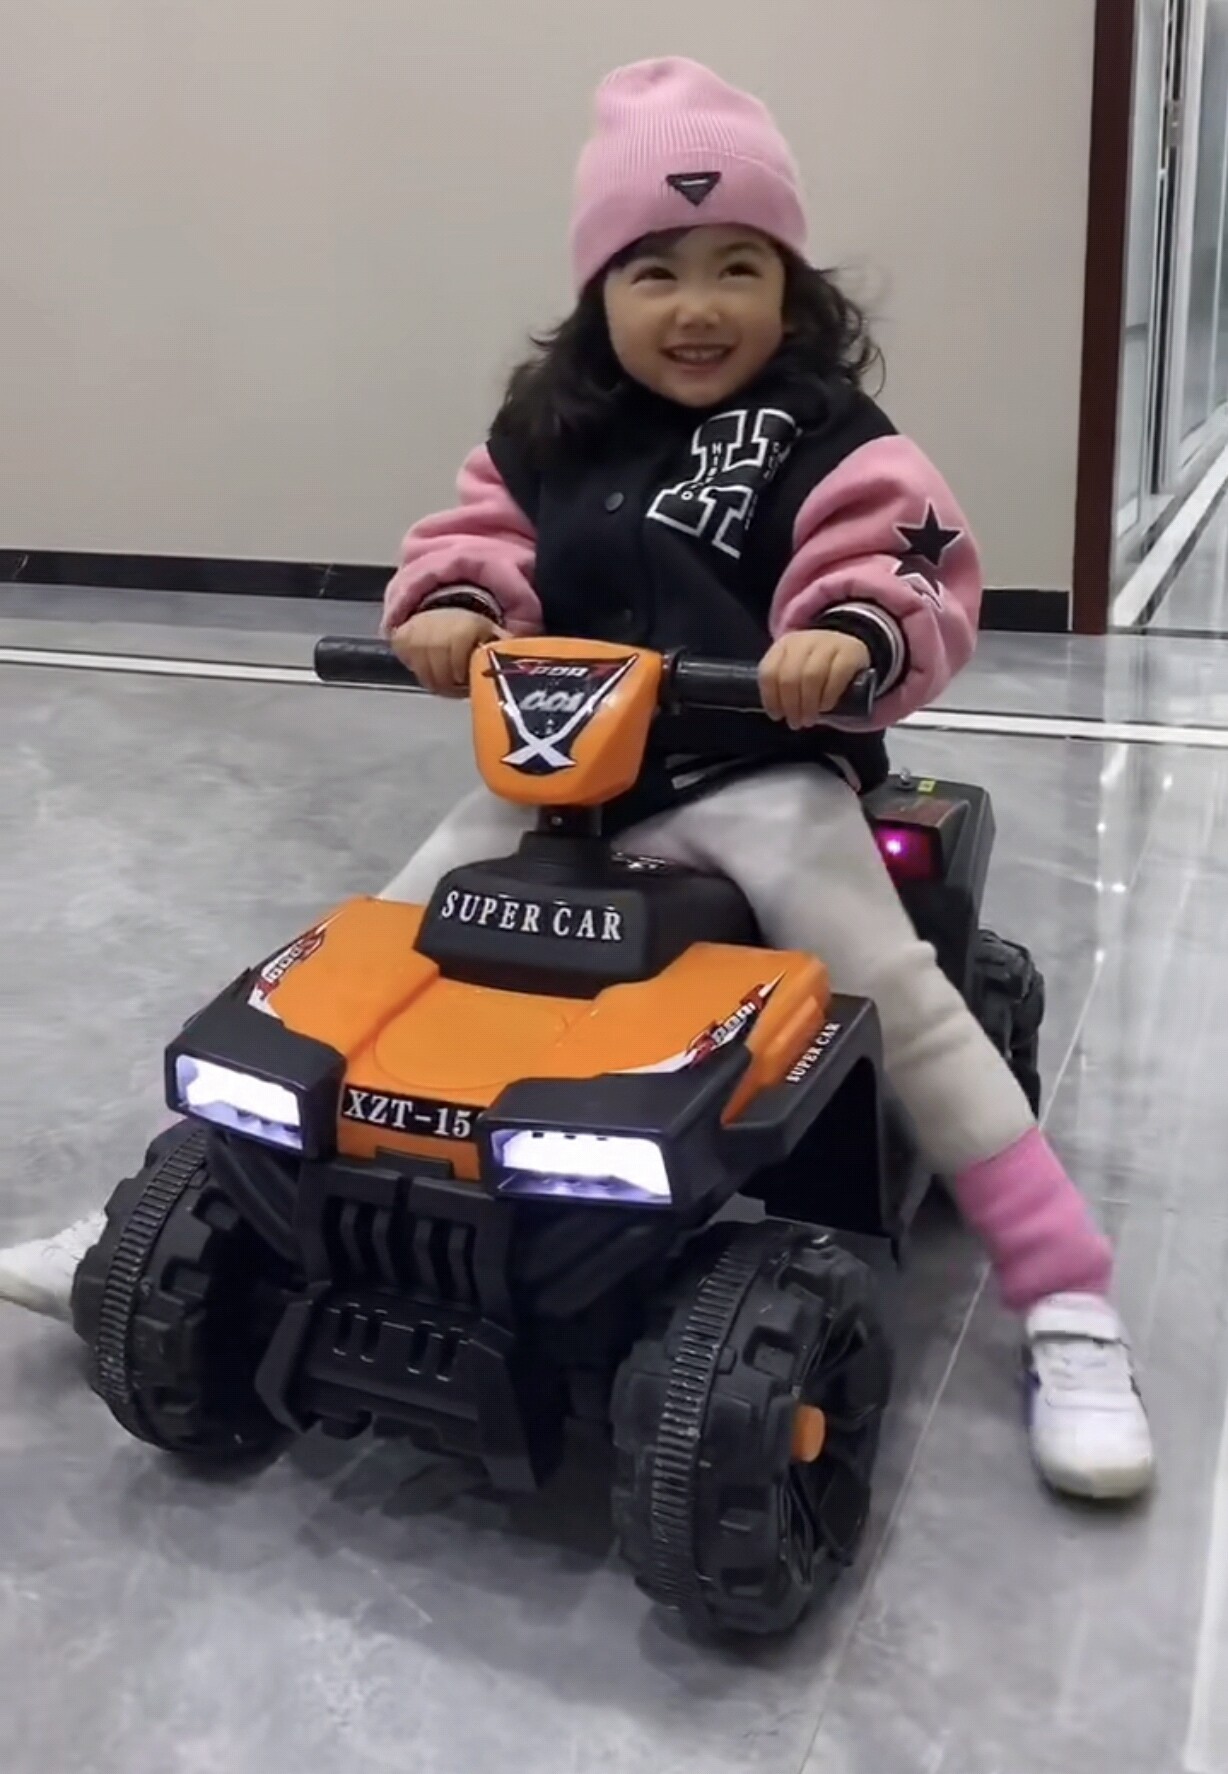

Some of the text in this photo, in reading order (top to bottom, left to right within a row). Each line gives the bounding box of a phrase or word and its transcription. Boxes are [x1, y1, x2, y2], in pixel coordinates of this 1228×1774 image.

[441, 889, 622, 941] SUPER CAR
[785, 1021, 842, 1084] SUPER CAR
[343, 1088, 484, 1138] XZT-15
